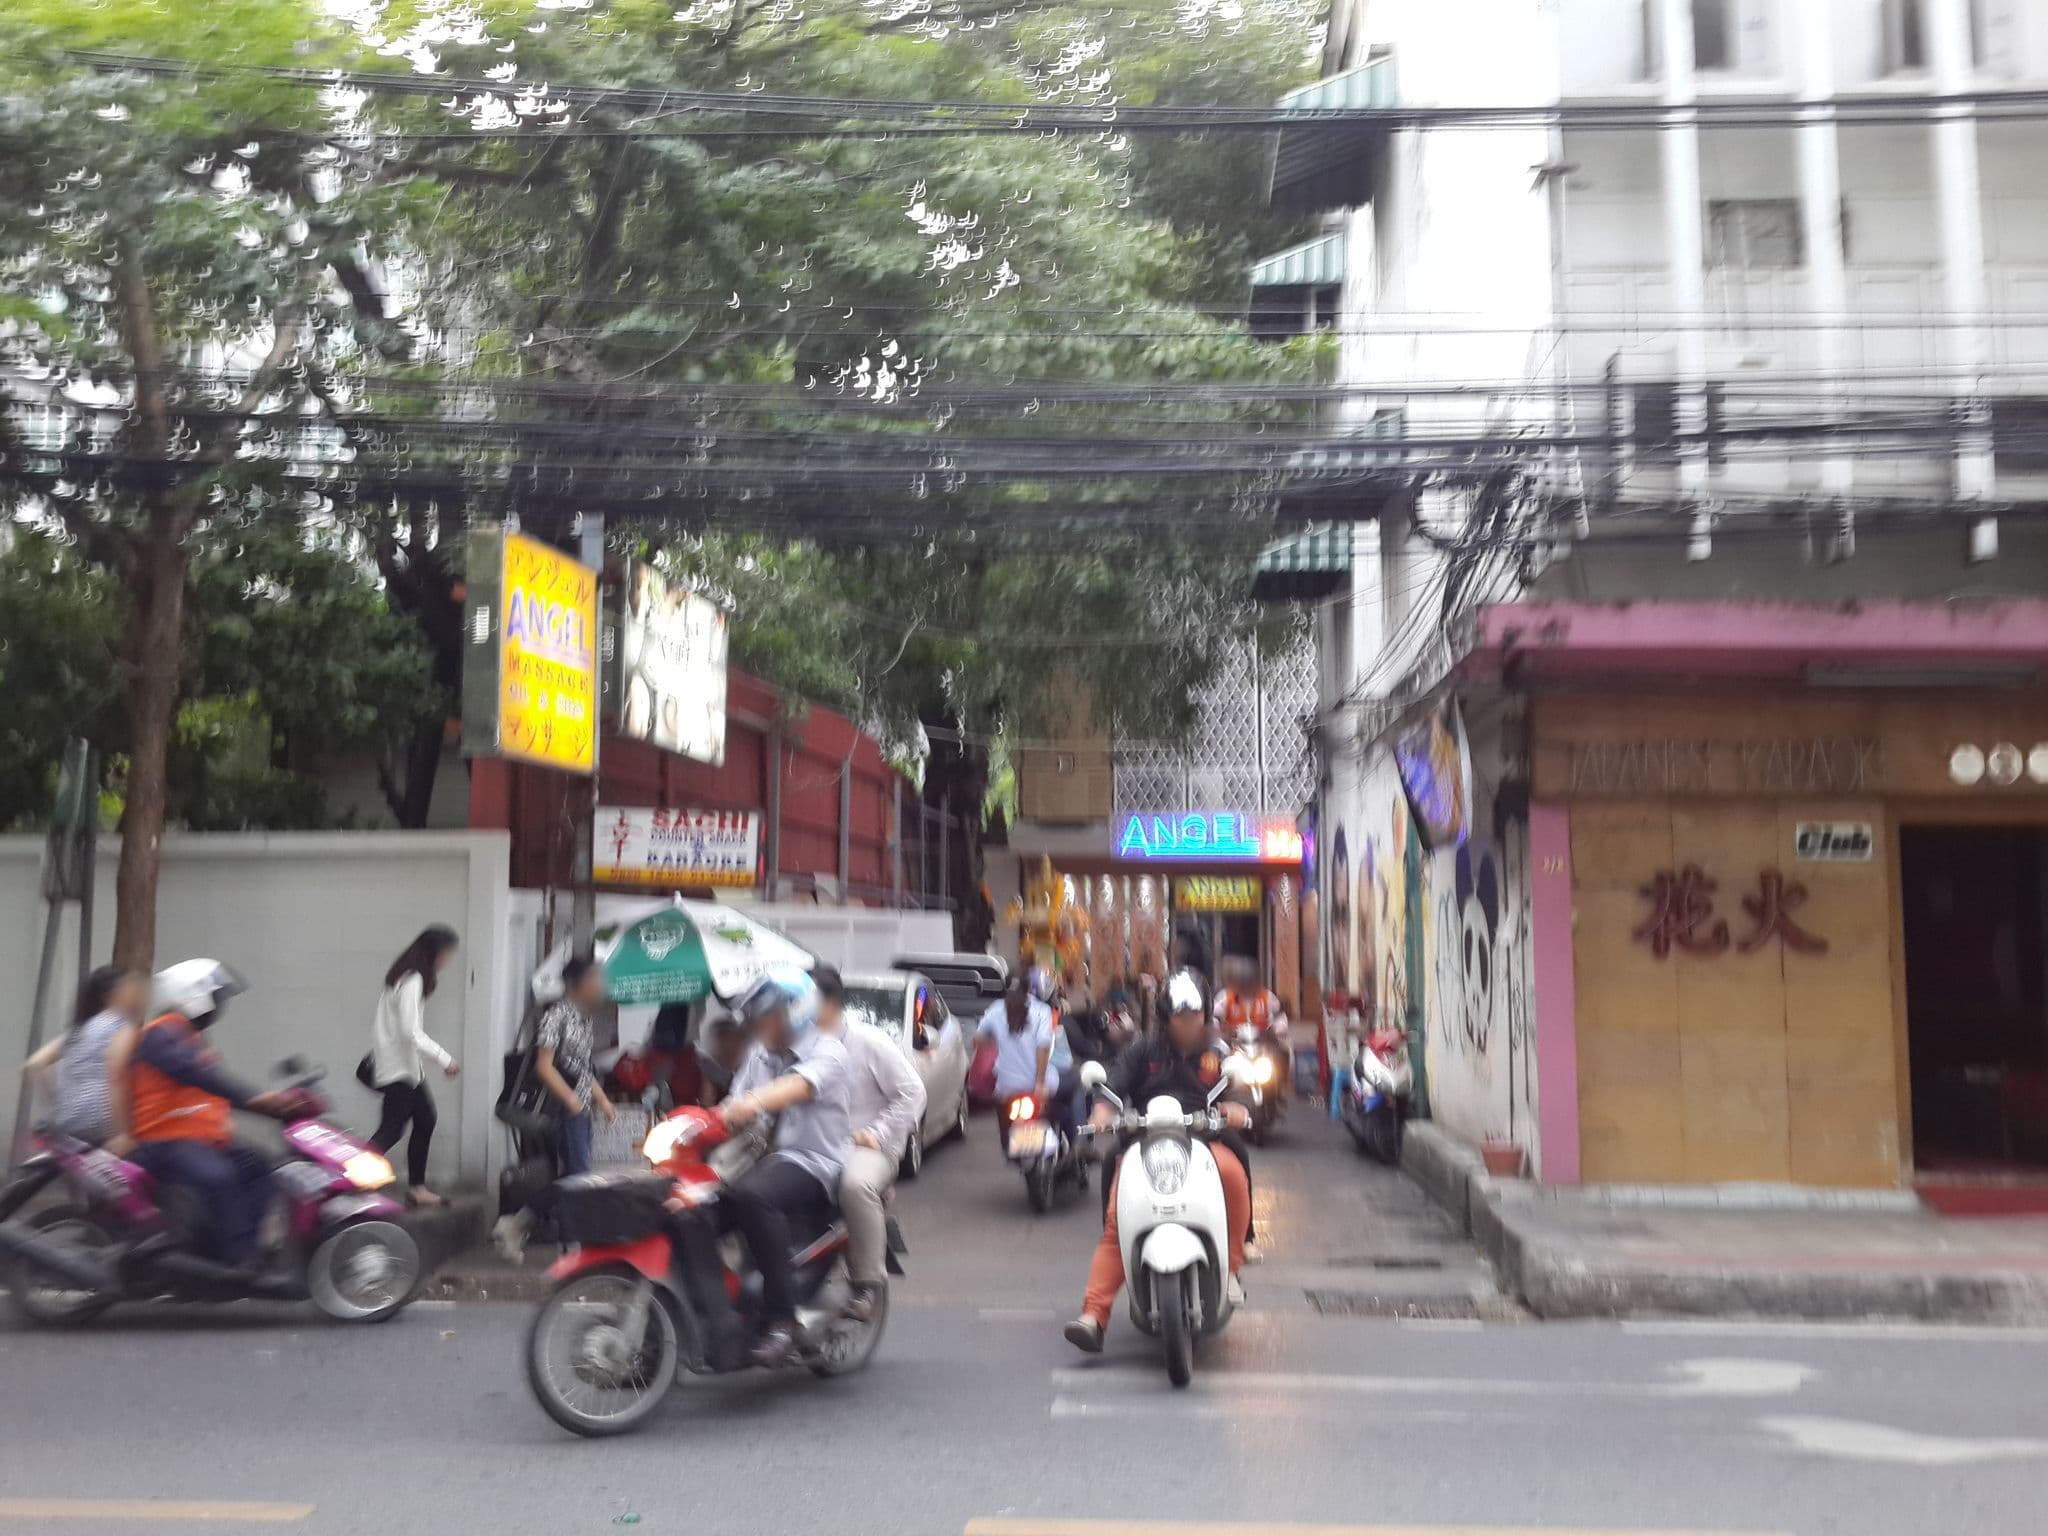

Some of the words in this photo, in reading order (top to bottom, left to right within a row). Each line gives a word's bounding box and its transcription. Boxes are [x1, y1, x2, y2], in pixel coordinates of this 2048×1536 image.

[507, 589, 589, 656] ANGEL
[1121, 813, 1260, 857] ANGEL
[1797, 826, 1871, 859] Club
[1632, 863, 1829, 963] 花火
